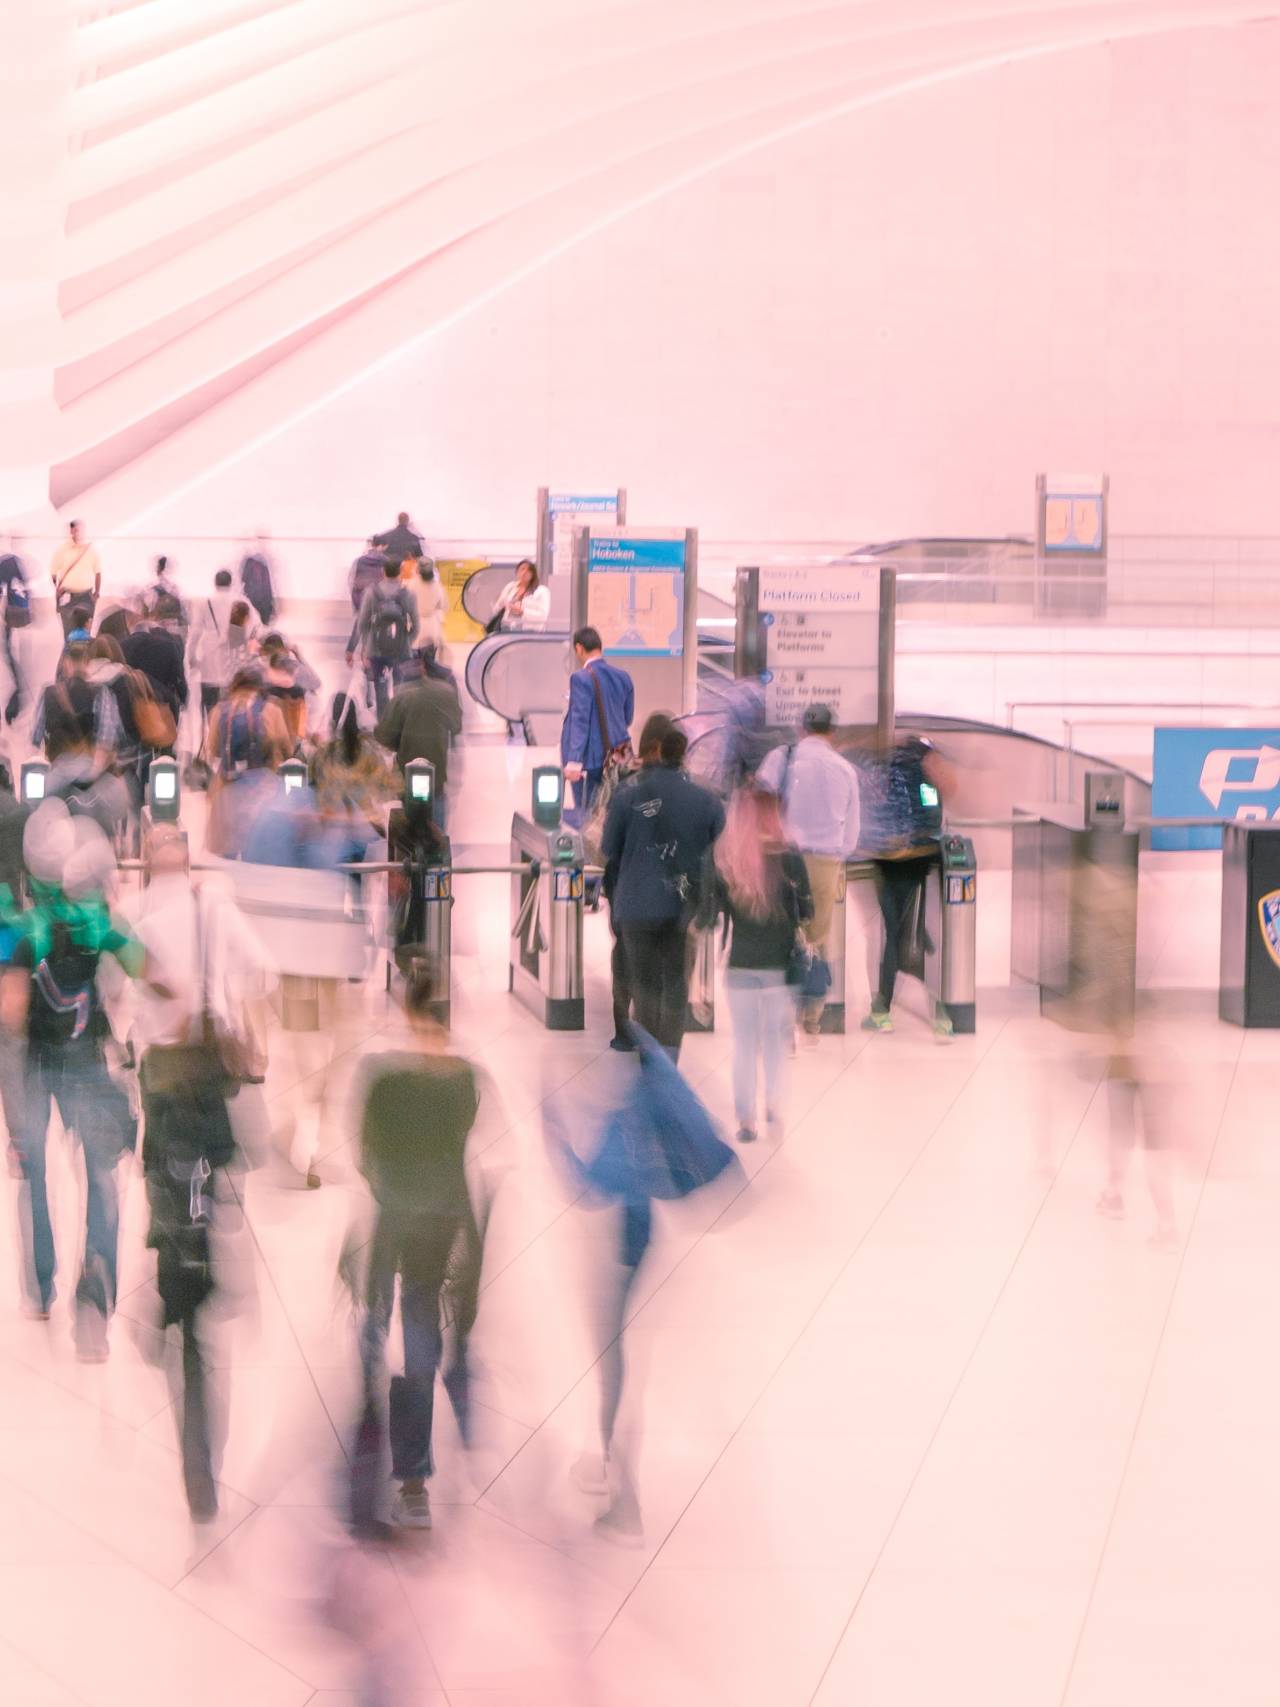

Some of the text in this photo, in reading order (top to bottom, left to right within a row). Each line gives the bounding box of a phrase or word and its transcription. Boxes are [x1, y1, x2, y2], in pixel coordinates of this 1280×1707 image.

[592, 548, 635, 560] Hoboken
[763, 590, 861, 601] Platform Closed
[777, 629, 832, 639] Elevator to
[777, 643, 825, 652] Platforms
[812, 686, 842, 696] Street
